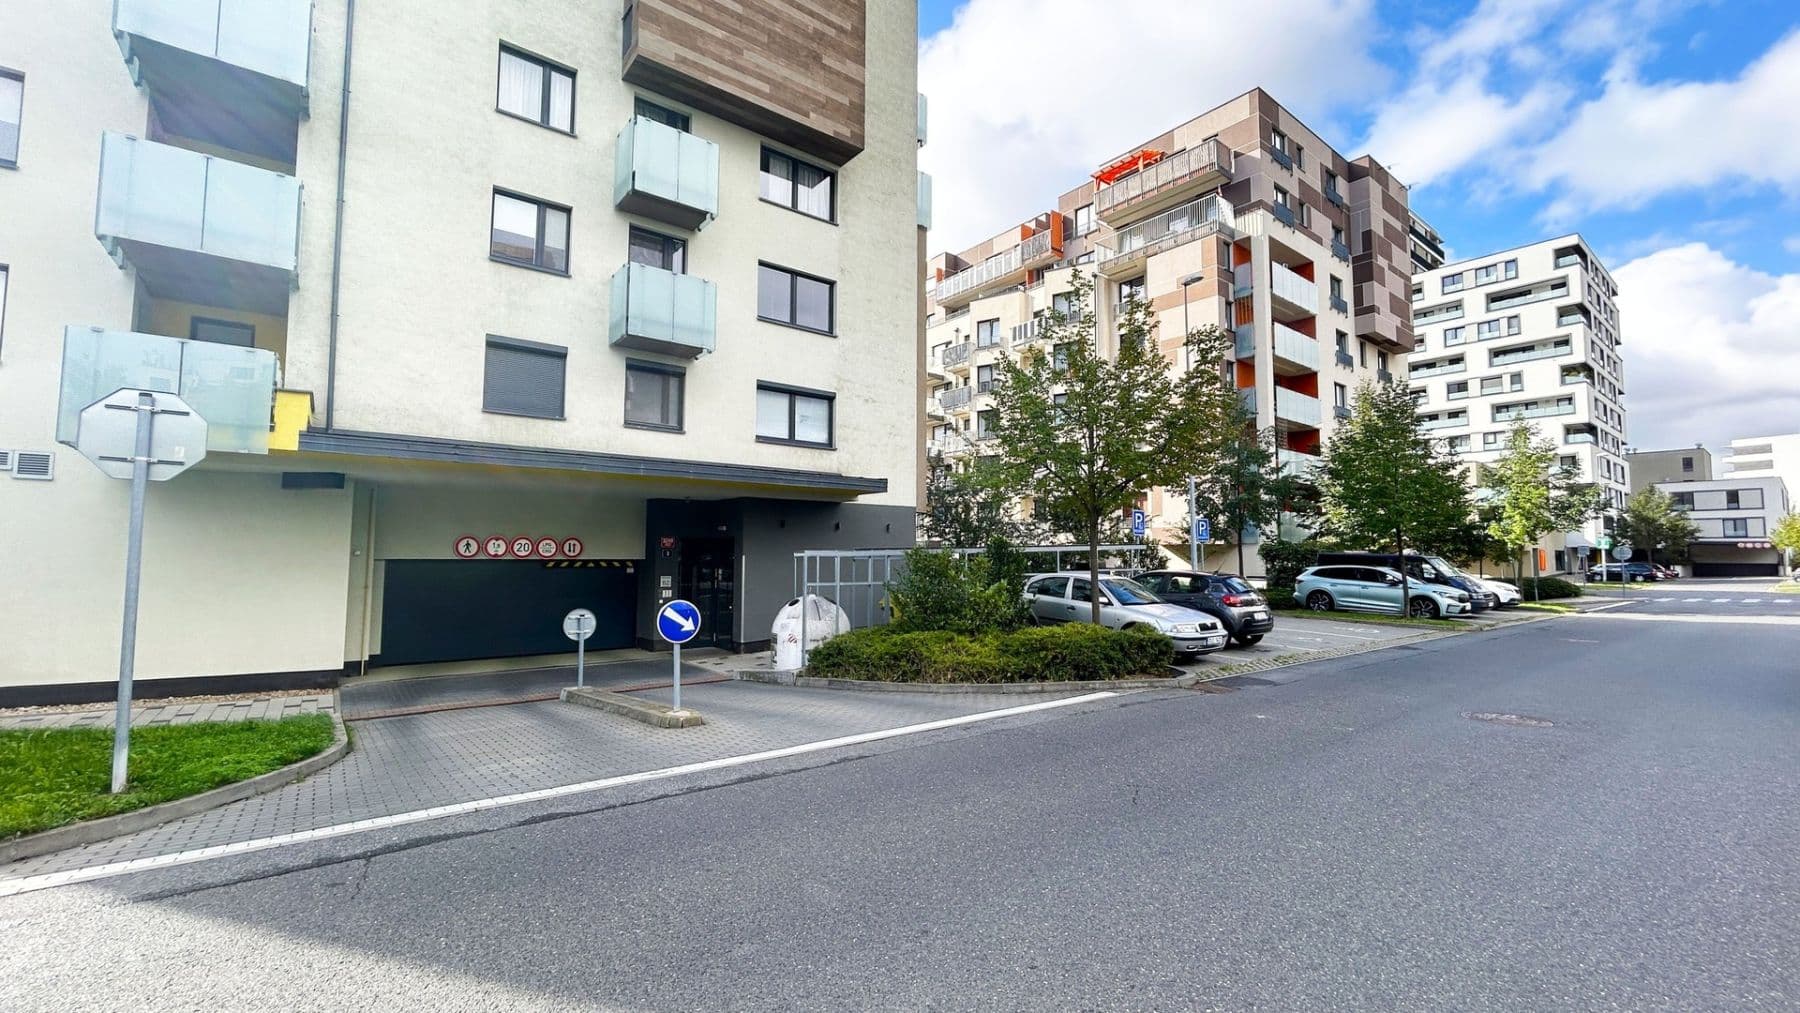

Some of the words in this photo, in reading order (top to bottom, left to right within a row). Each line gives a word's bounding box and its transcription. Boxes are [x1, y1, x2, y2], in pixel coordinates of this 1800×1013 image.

[1135, 513, 1143, 528] P
[1199, 521, 1207, 535] P
[516, 542, 530, 552] 20
